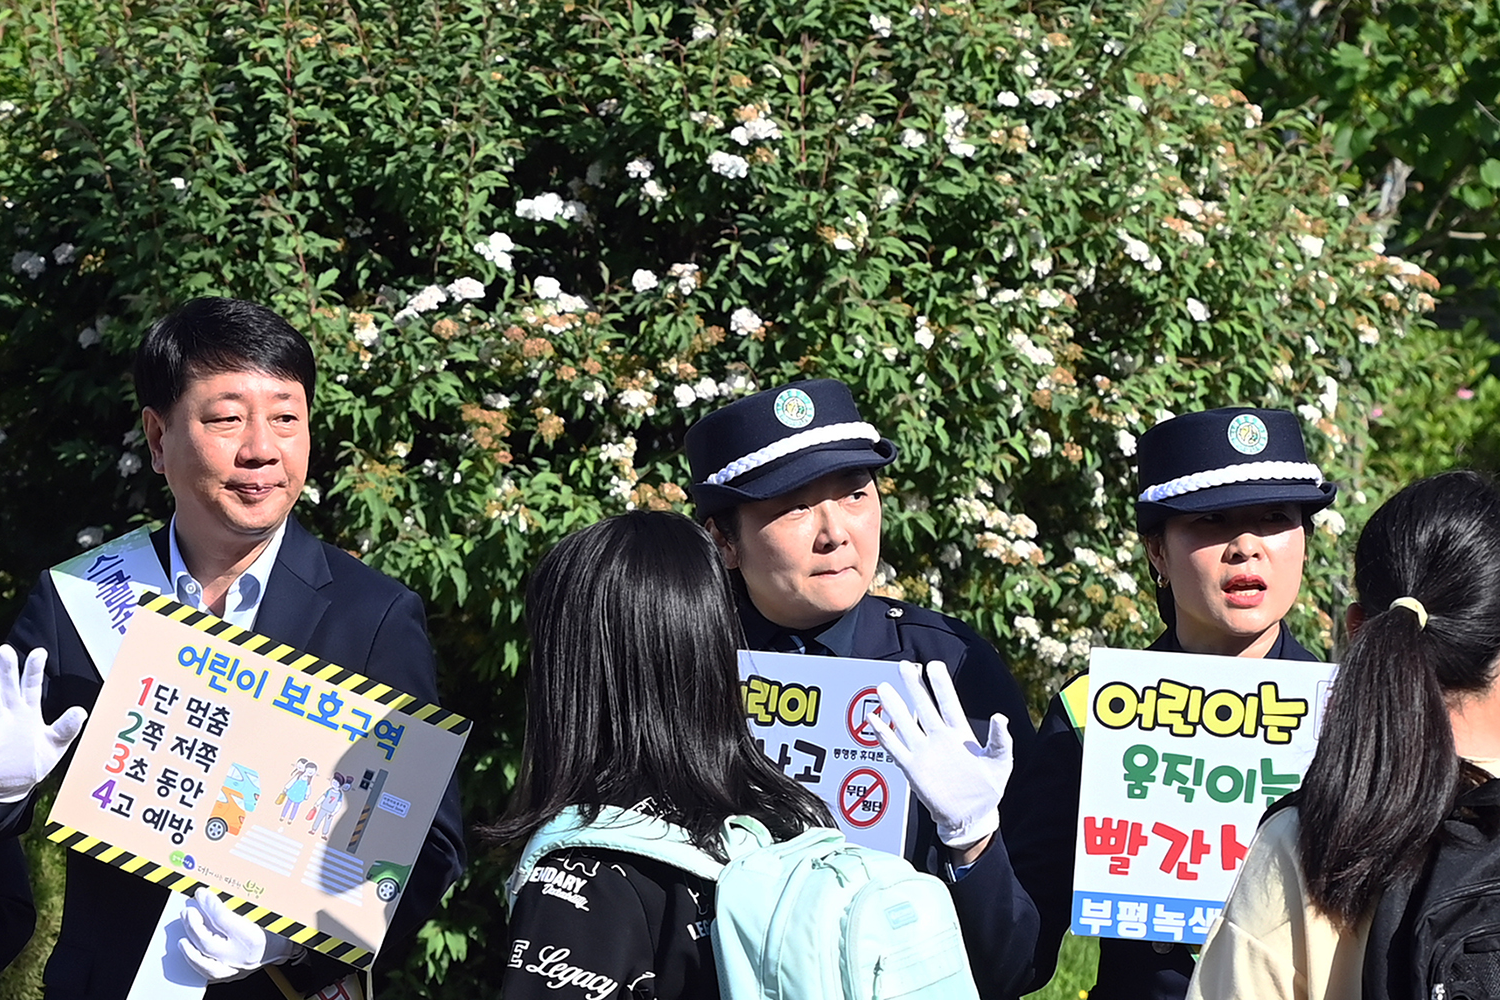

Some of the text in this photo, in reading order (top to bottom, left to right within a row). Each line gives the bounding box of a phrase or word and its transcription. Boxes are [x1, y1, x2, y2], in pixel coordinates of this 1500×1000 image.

[137, 677, 231, 738] 1단 멈춤
[177, 644, 406, 762] 어린이 보호구역
[740, 675, 820, 726] 린이
[1093, 678, 1308, 744] 어린이는
[118, 711, 220, 774] 2쪽 저쪽
[757, 738, 827, 784] 고
[860, 750, 884, 762] 휴대폰
[104, 743, 205, 811] 3초 동안
[1122, 744, 1301, 808] 움직이는
[92, 779, 194, 847] 4고 예방
[1083, 816, 1211, 881] 빨간
